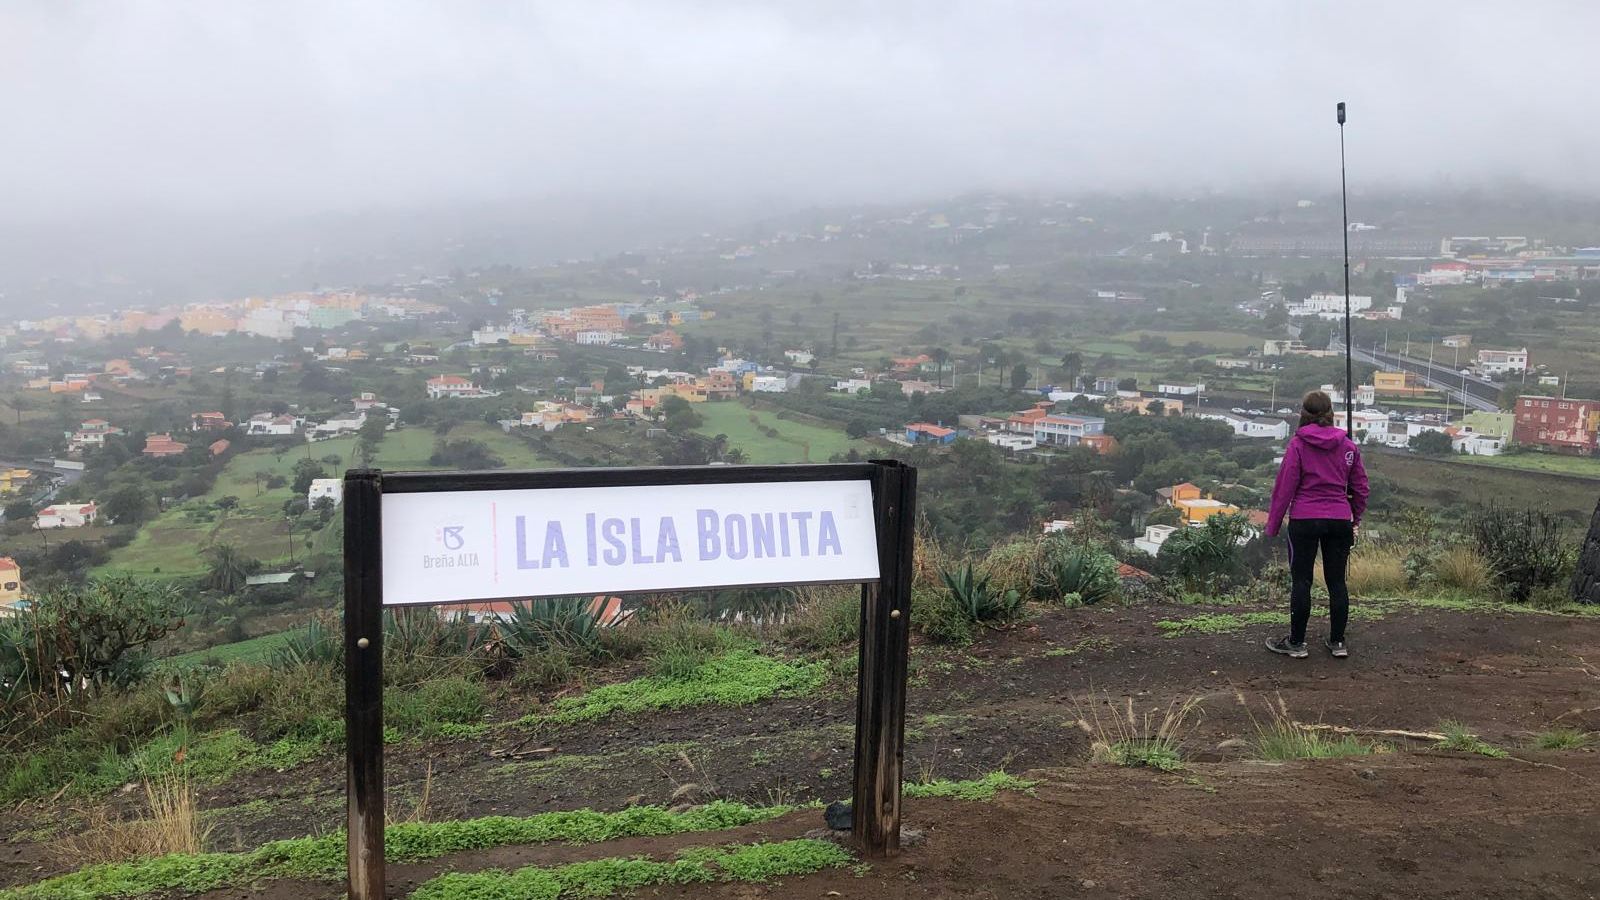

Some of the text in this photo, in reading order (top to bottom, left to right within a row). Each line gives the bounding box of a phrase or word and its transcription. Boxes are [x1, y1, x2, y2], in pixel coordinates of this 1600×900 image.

[515, 508, 843, 570] LA ISLA BONITA
[423, 552, 480, 569] Breña ALTA
